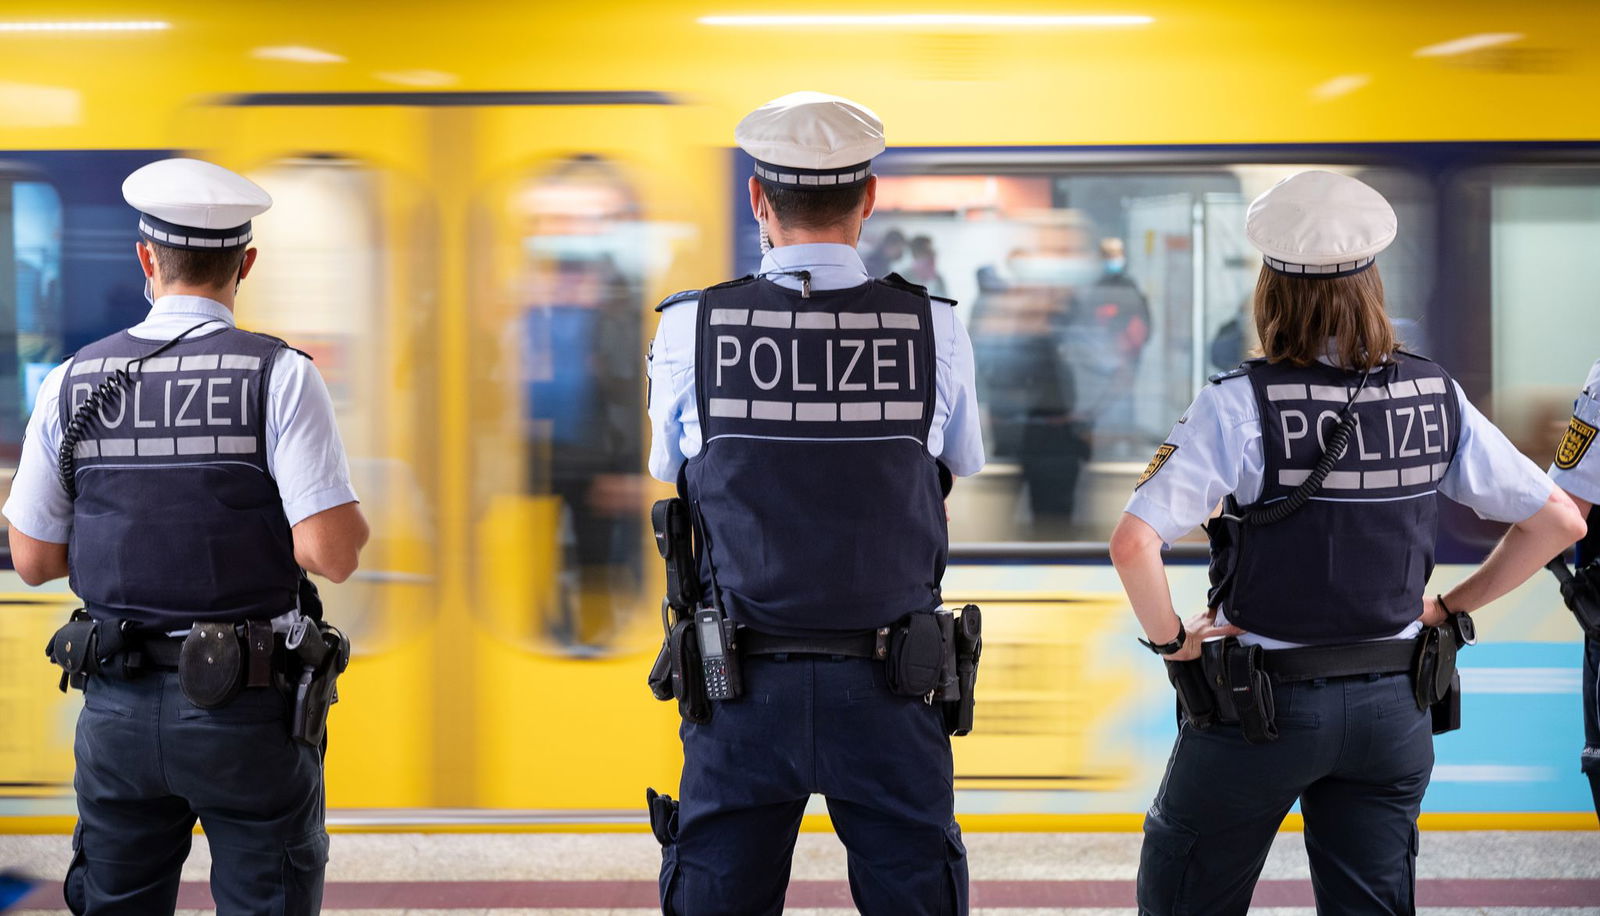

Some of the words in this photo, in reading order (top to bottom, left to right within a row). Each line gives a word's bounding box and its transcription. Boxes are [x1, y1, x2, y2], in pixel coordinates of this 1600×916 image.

[716, 335, 916, 392] POLIZEI
[71, 377, 249, 429] POLIZEI
[1280, 403, 1449, 461] POLIZEI
